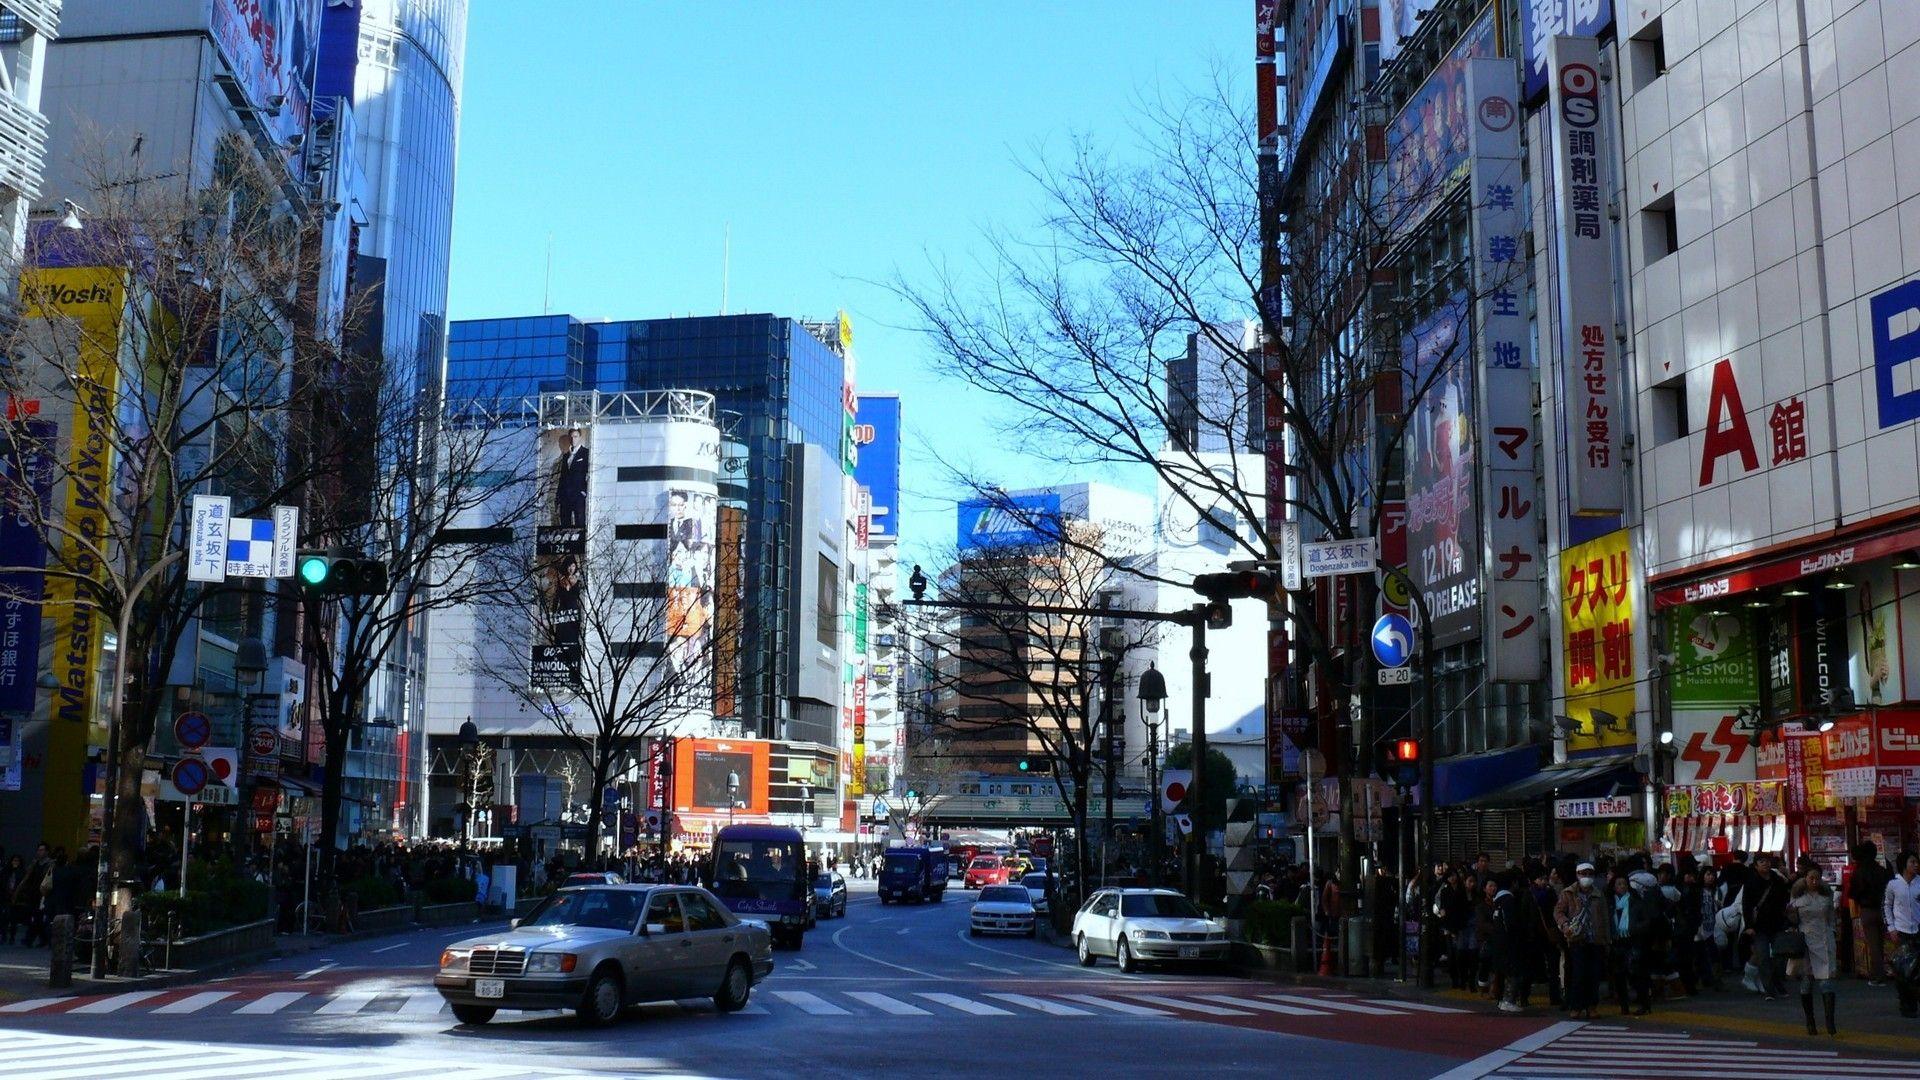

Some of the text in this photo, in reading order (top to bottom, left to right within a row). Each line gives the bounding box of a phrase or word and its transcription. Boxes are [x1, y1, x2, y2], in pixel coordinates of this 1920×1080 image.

[1569, 130, 1601, 240] 調剤薬局
[1486, 184, 1521, 369] 洋装生地
[1581, 324, 1610, 468] 処方せん受付
[204, 504, 225, 574] 道玄坂下
[1308, 543, 1369, 564] 道玄坂下
[1310, 561, 1349, 573] Dogenzaka
[1422, 537, 1454, 586] 12.19
[1494, 427, 1534, 639] マルナン
[227, 562, 269, 577] 時差式
[1436, 578, 1477, 618] RELEASE
[1567, 550, 1628, 619] クスリ
[1685, 578, 1729, 602] ビックカメラ
[1569, 618, 1632, 688] 調剤
[1816, 617, 1830, 706] WILLCOM
[1826, 727, 1870, 761] ビックカメラ
